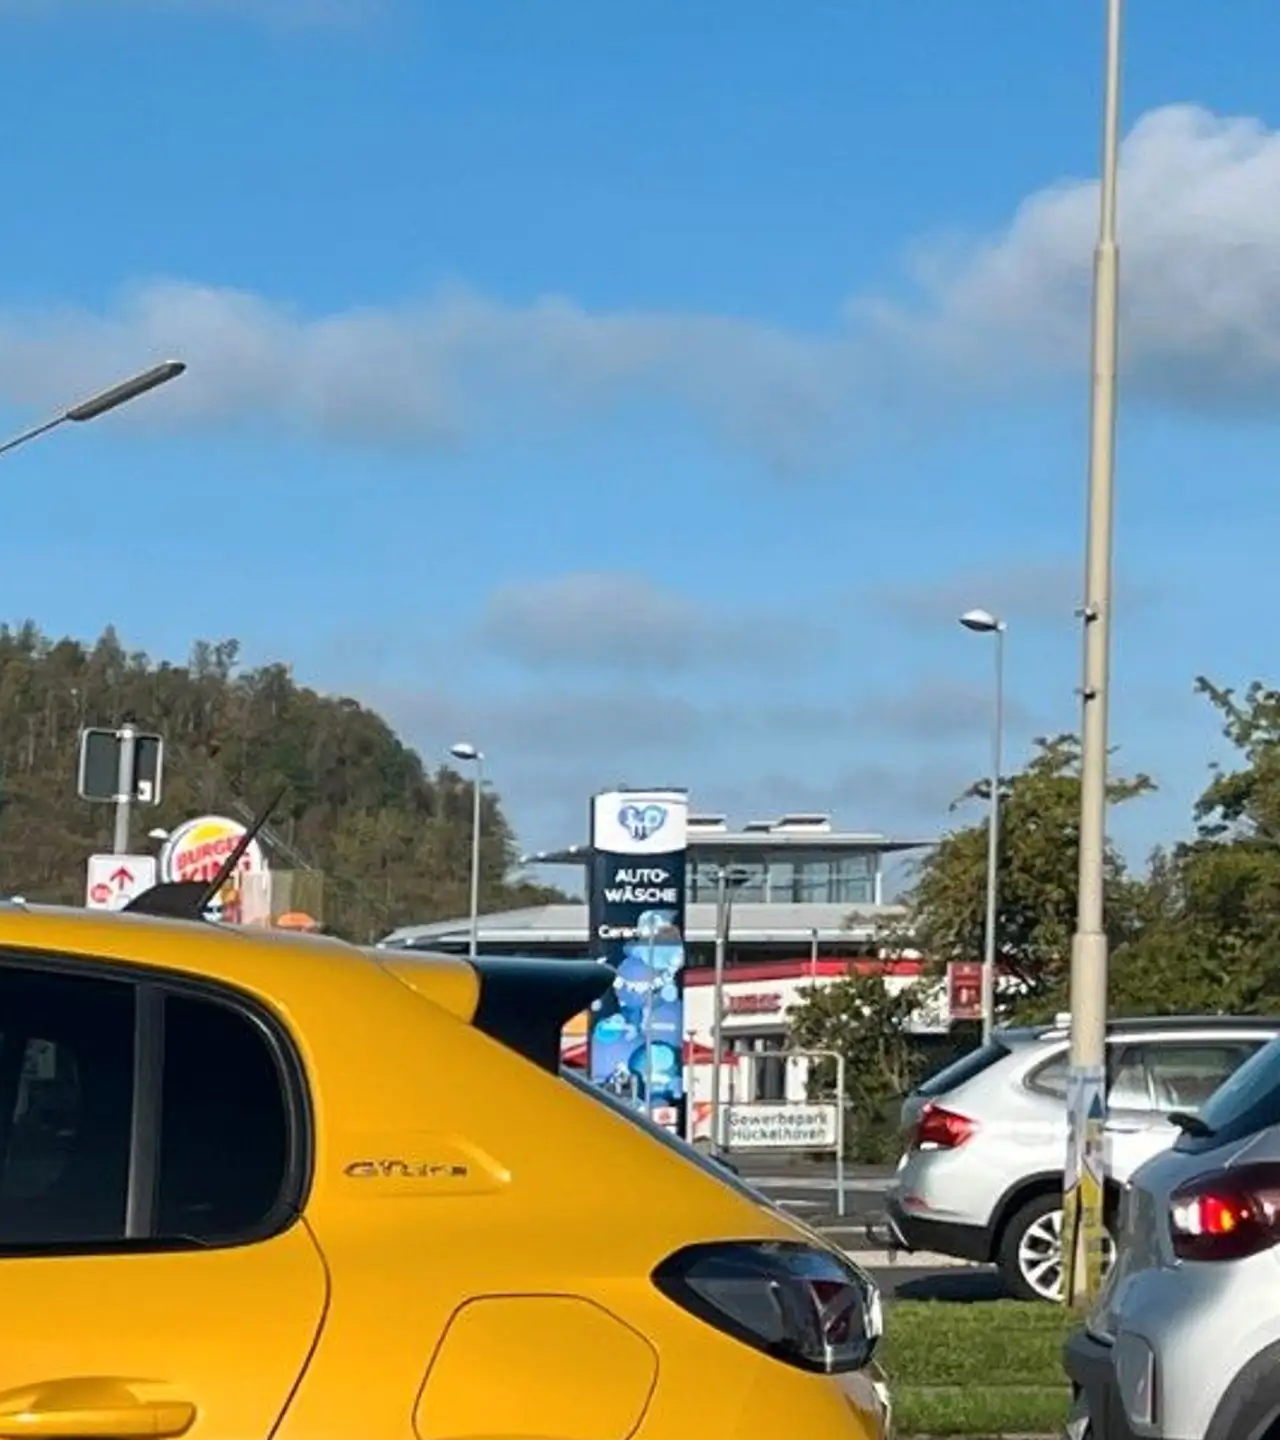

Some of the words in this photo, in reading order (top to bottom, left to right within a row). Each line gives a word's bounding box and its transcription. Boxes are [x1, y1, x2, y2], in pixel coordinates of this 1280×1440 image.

[178, 835, 247, 868] BURGE
[614, 868, 670, 883] AUTO-
[604, 886, 678, 903] WÄSCHE
[729, 1111, 828, 1127] Gewerbepark
